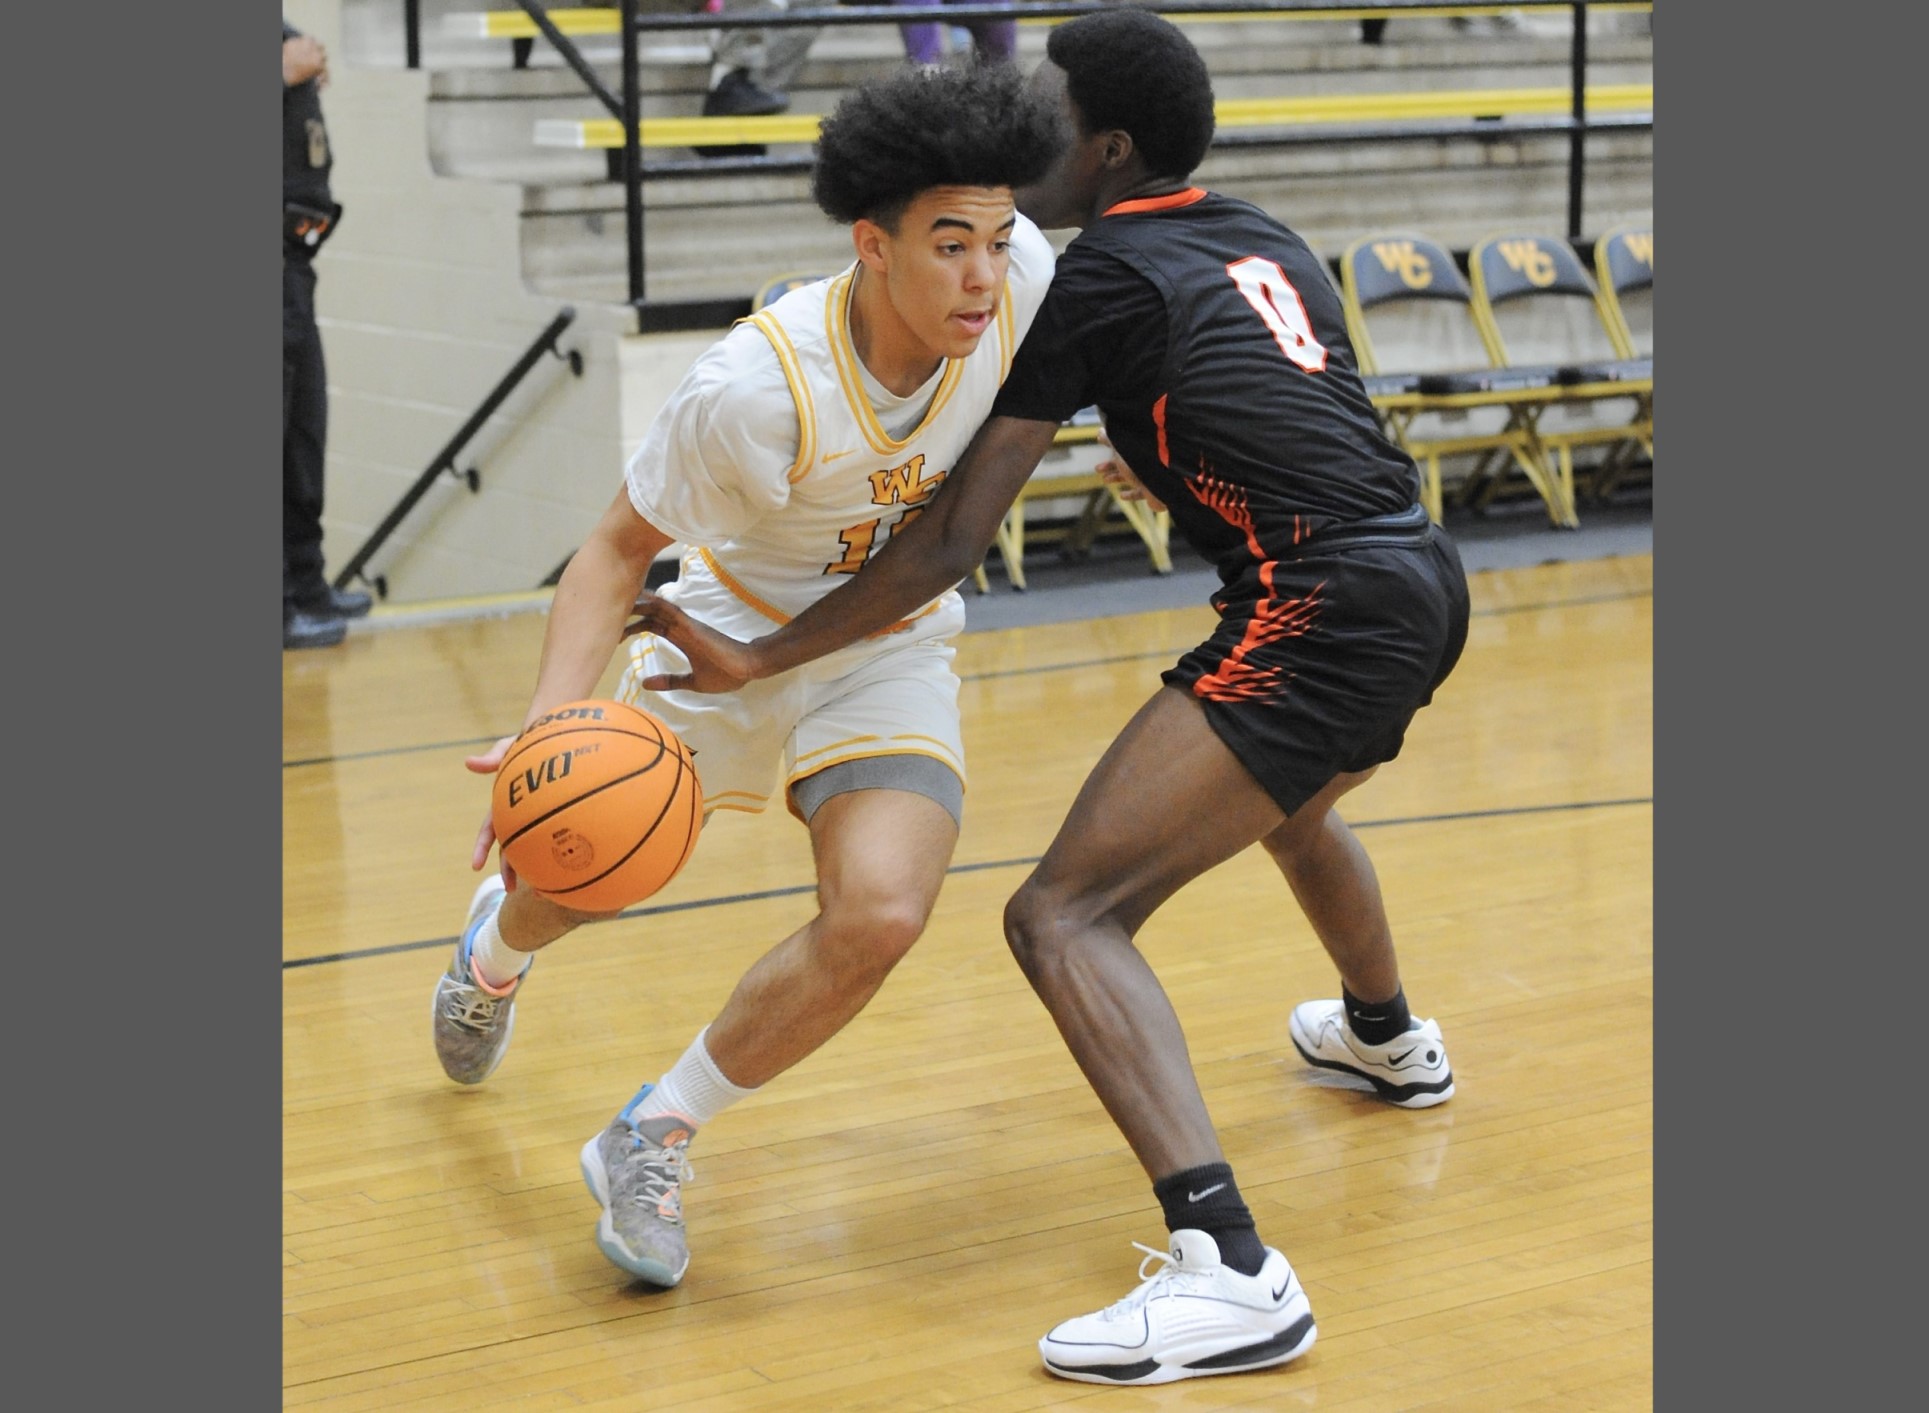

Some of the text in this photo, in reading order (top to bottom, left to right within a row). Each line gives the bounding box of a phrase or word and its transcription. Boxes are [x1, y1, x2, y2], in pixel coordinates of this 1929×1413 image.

[1372, 241, 1433, 289] WC
[1497, 239, 1557, 288] WC
[1624, 233, 1653, 270] W
[1225, 255, 1328, 374] 0
[822, 505, 925, 575] 1
